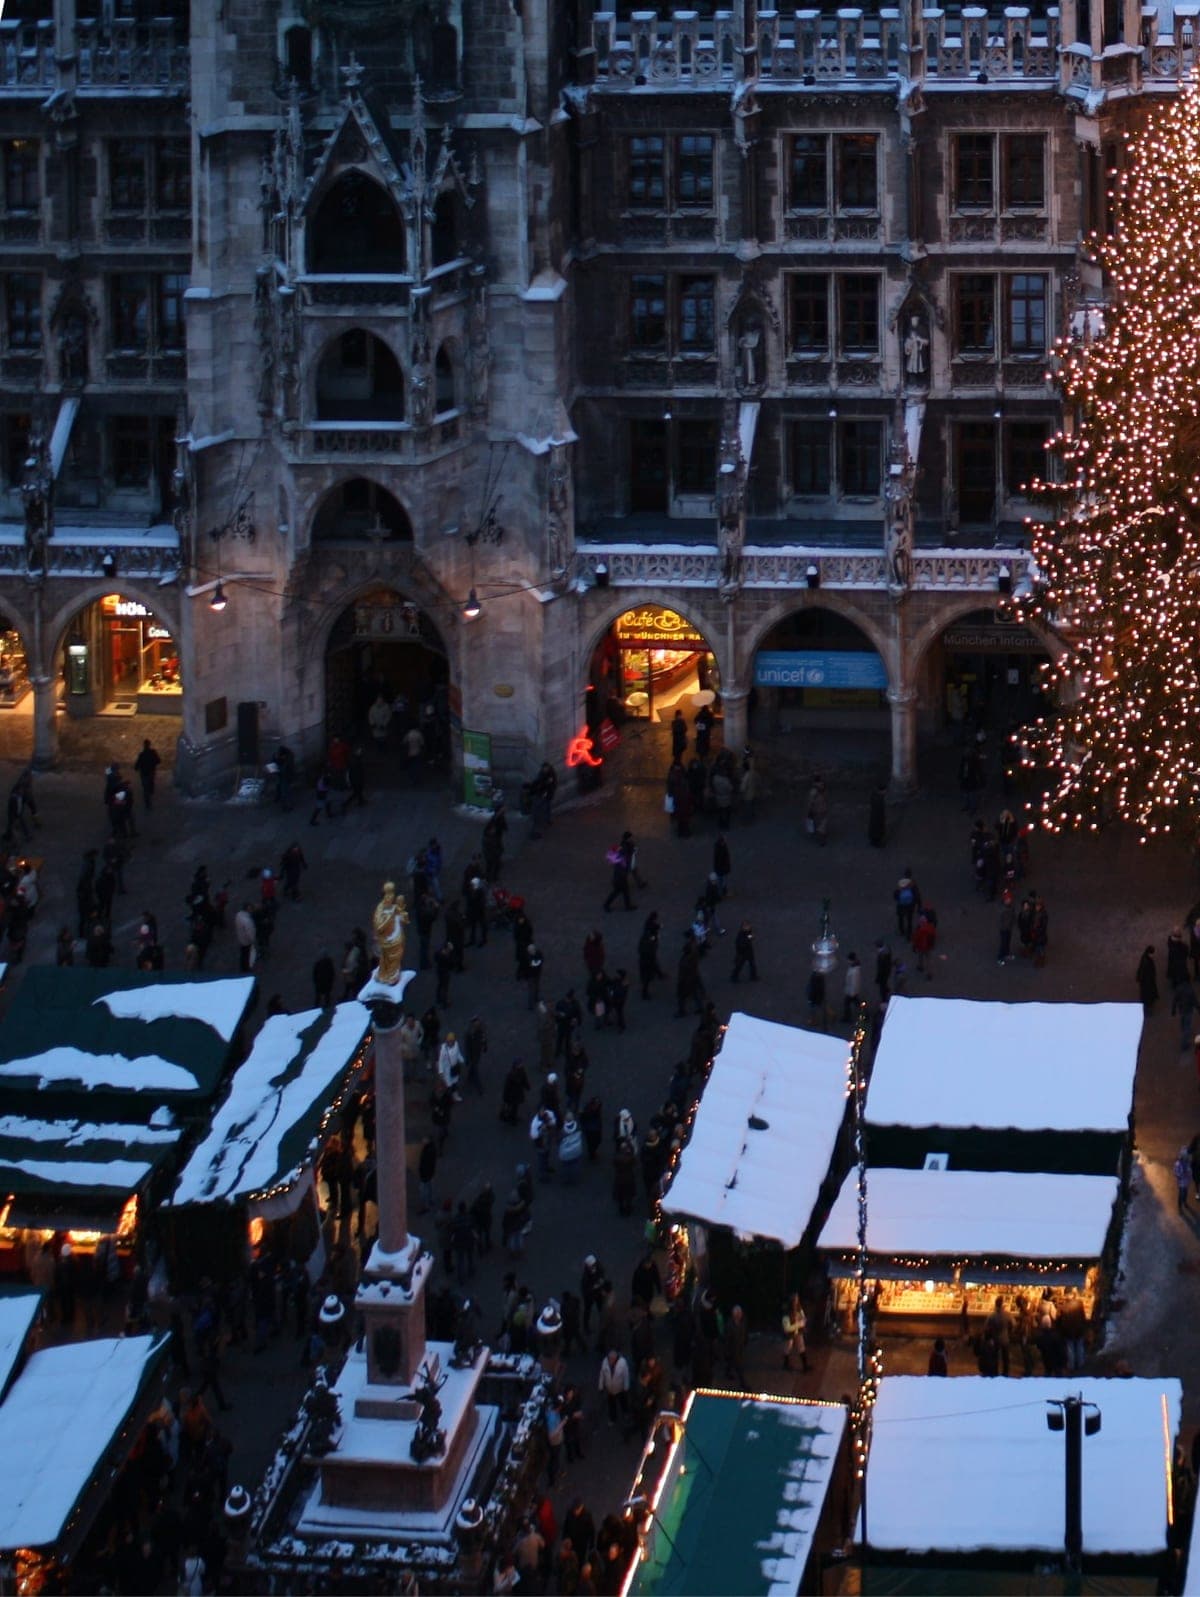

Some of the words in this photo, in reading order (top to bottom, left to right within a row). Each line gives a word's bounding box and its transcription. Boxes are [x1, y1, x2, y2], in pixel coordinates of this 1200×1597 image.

[623, 610, 654, 629] Café
[943, 634, 998, 647] München
[1000, 634, 1040, 647] Inform
[757, 667, 805, 682] unicef
